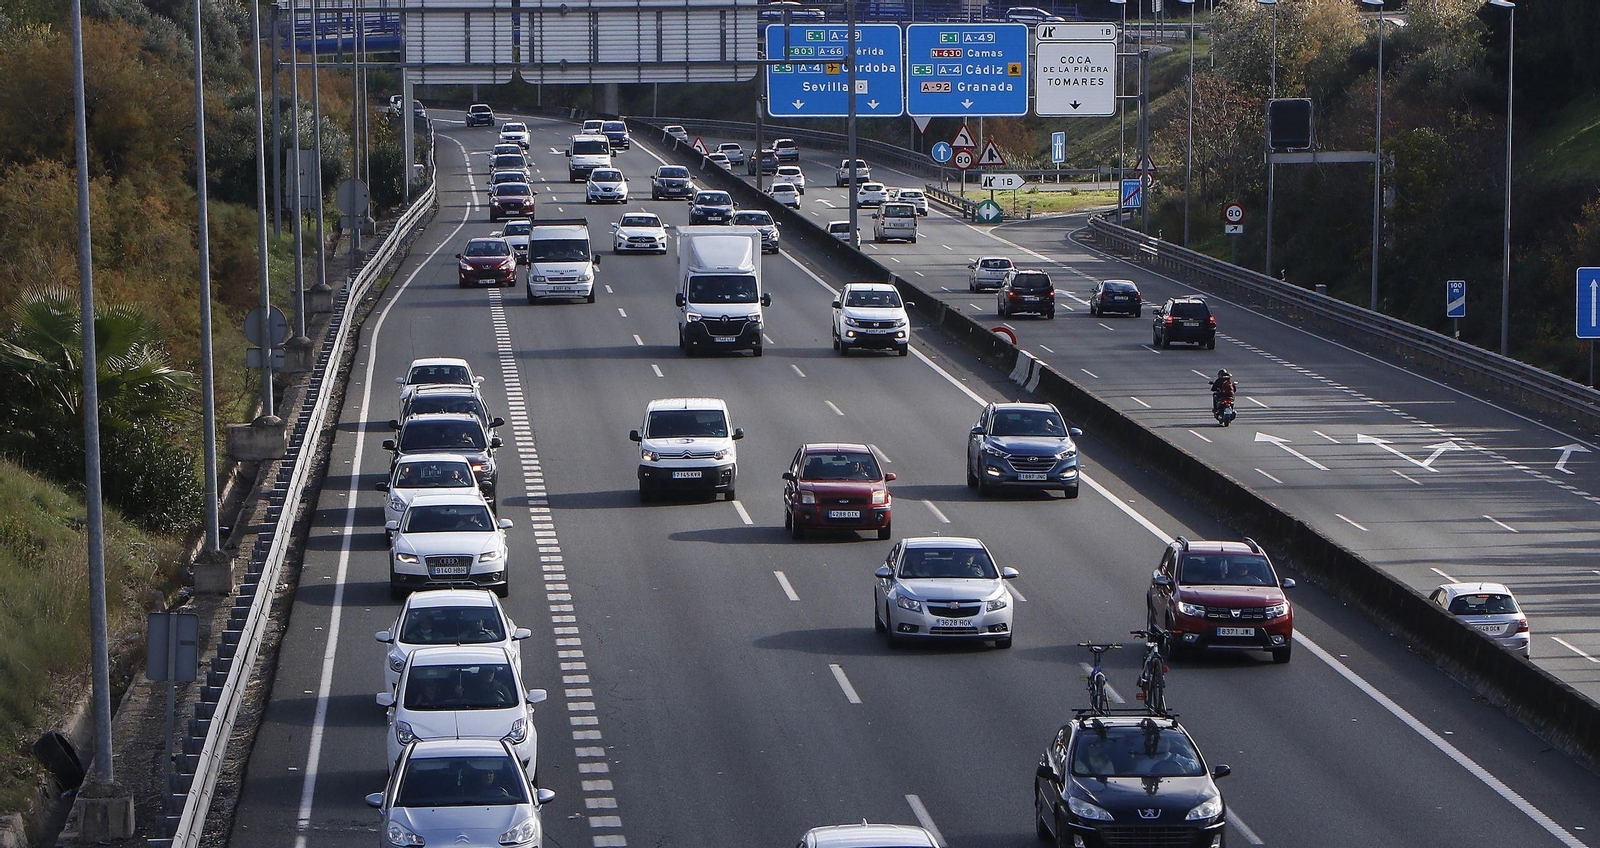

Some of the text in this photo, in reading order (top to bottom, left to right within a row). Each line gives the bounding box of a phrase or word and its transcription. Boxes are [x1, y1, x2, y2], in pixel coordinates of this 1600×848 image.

[807, 32, 824, 40] E-1
[941, 33, 994, 42] E-1 A-49
[855, 47, 884, 55] érida
[932, 49, 1003, 58] N-630 Camas
[1060, 56, 1091, 64] COCA
[773, 64, 792, 72] E-5
[799, 64, 821, 72] A-4
[913, 64, 1004, 75] E-5 A-4 Cádiz
[1074, 65, 1109, 73] PIÑERA
[1048, 78, 1104, 86] TOMARES
[802, 82, 849, 92] Sevilla
[922, 82, 1013, 92] A-92 Granada
[957, 156, 970, 164] 80
[1001, 178, 1013, 186] 1B
[1228, 209, 1241, 217] 80
[940, 619, 958, 627] 3628
[1221, 628, 1238, 636] 8371
